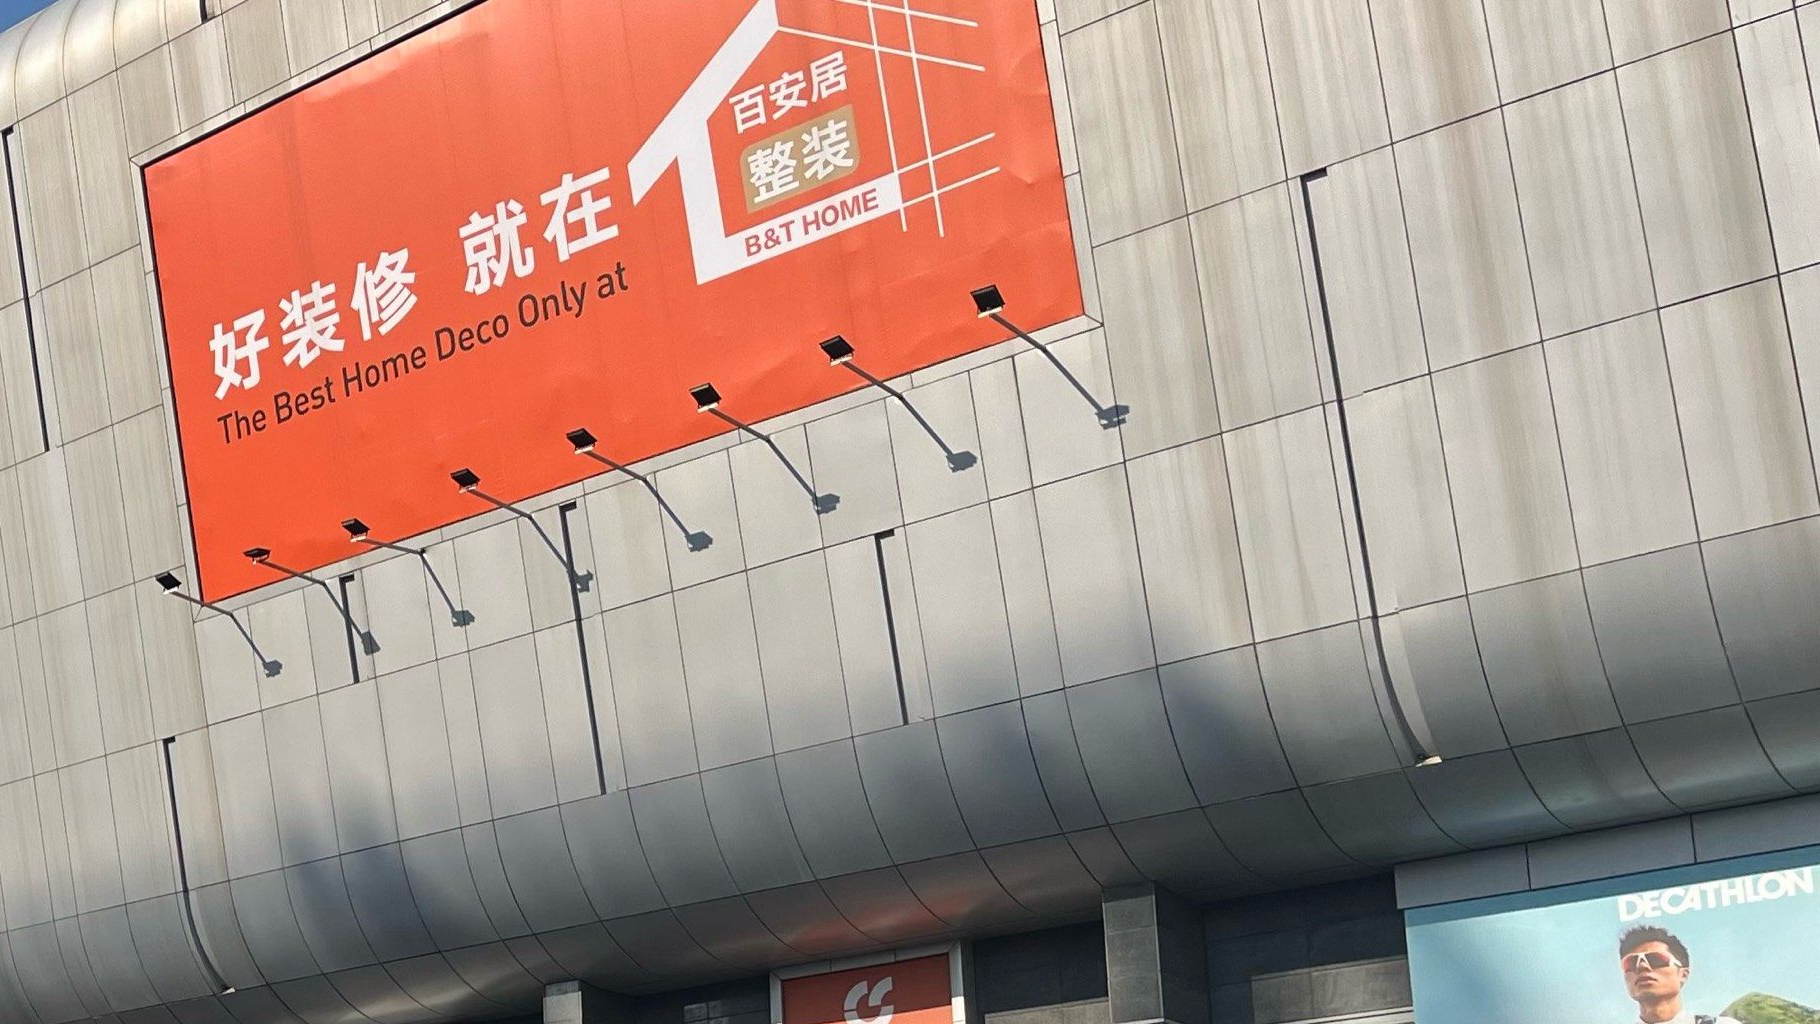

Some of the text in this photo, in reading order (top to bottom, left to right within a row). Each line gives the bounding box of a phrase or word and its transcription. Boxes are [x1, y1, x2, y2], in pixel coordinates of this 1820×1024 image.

[729, 49, 850, 134] 百安居
[746, 117, 856, 206] 整装
[743, 187, 879, 257] B&T HOME
[210, 166, 620, 400] 好装修 就在
[218, 261, 628, 446] The Best Home Deco Only at
[1617, 867, 1814, 922] DECATHLON
